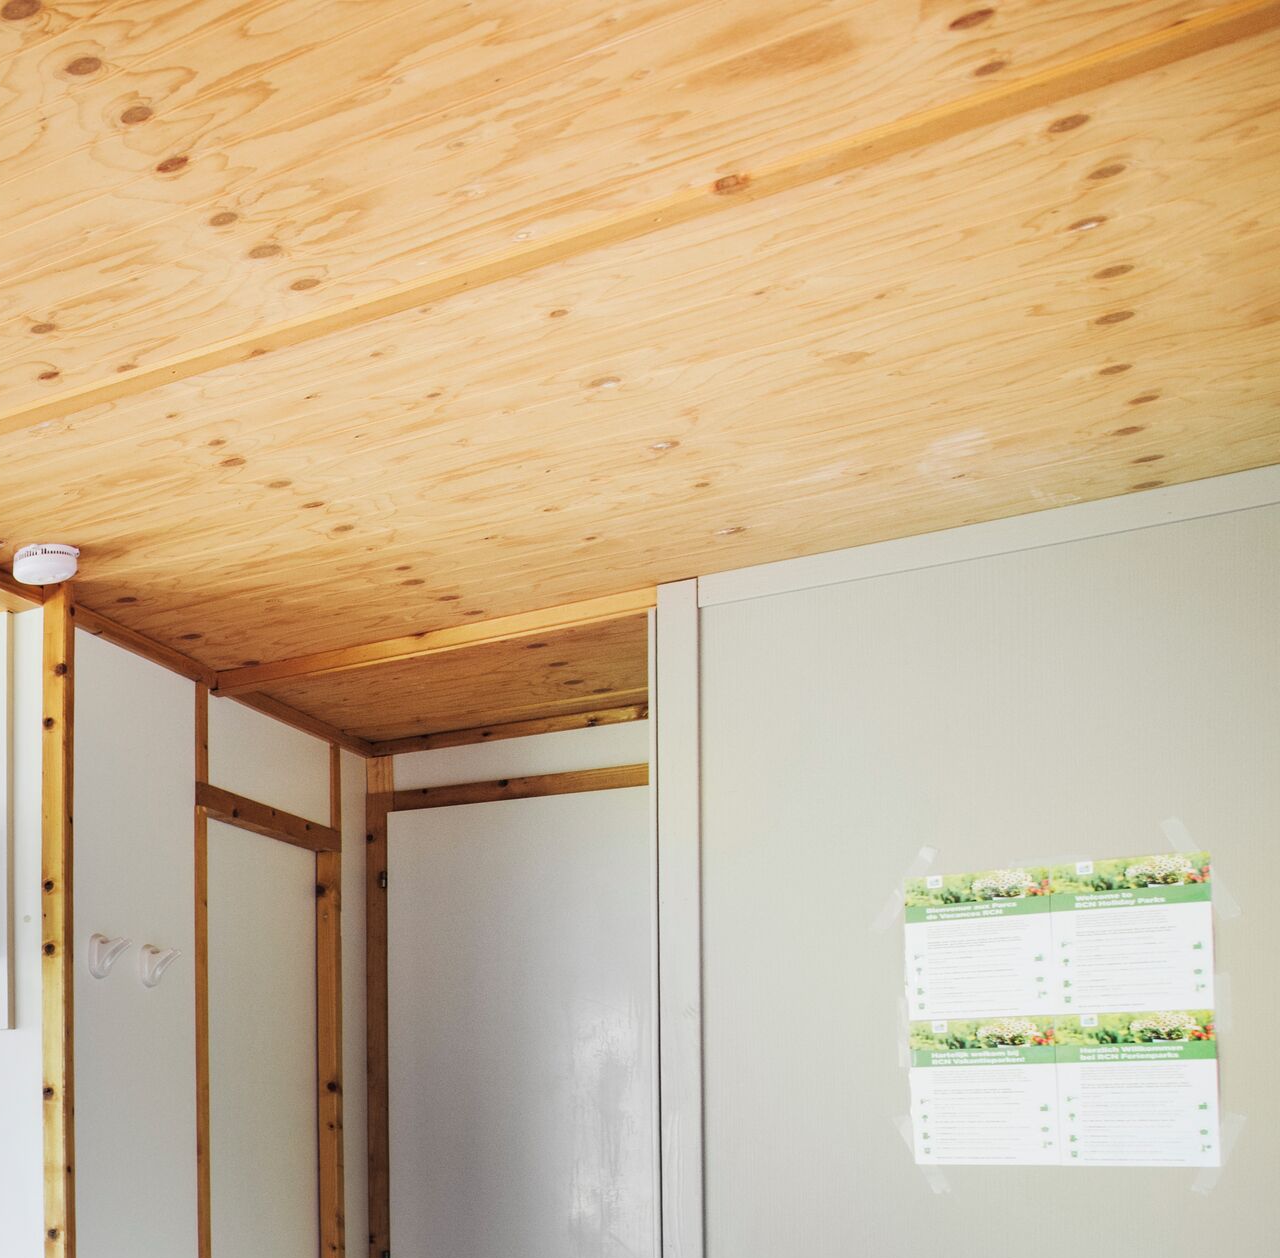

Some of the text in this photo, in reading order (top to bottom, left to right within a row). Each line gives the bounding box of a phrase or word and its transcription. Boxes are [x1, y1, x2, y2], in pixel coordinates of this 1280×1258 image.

[1075, 893, 1120, 902] Welcome
[1074, 896, 1166, 909] RCN Holiday Parks
[926, 905, 972, 914] Bienvenue
[982, 908, 1003, 916] RCN
[1080, 1044, 1184, 1054] Herzlich Willkommen
[1121, 1051, 1180, 1060] Ferienparks
[931, 1058, 952, 1066] RCN
